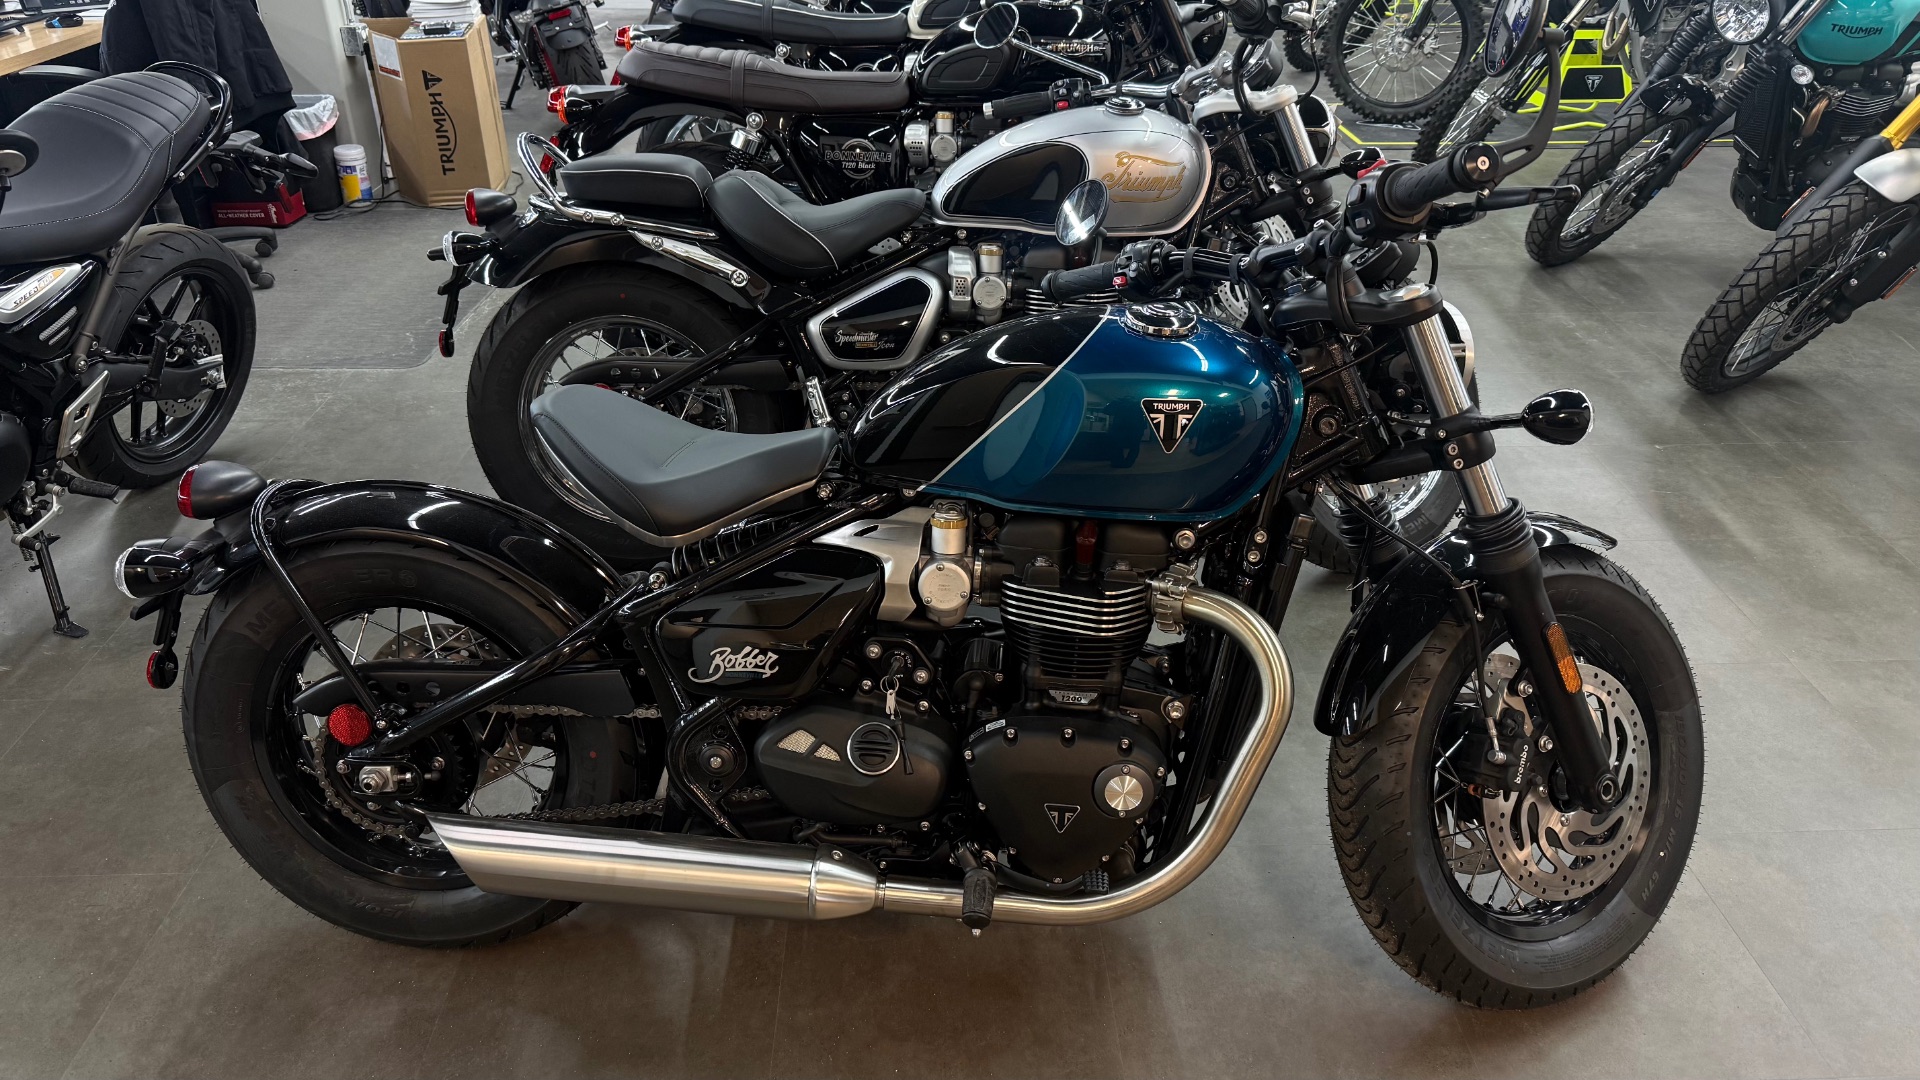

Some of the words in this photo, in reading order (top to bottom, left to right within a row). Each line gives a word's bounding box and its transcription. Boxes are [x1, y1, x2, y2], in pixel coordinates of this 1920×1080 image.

[1831, 23, 1884, 39] TRIUMPH
[428, 92, 457, 176] TRIUMPH
[824, 150, 892, 162] BONNEVILLE
[842, 161, 856, 169] T120
[858, 161, 876, 169] Black
[1101, 151, 1186, 203] Triumph
[13, 286, 39, 306] SPEED
[835, 330, 879, 346] Speedmaster
[1152, 402, 1190, 413] TRIUMPH
[688, 645, 779, 683] Bobber
[1514, 744, 1529, 784] brembo
